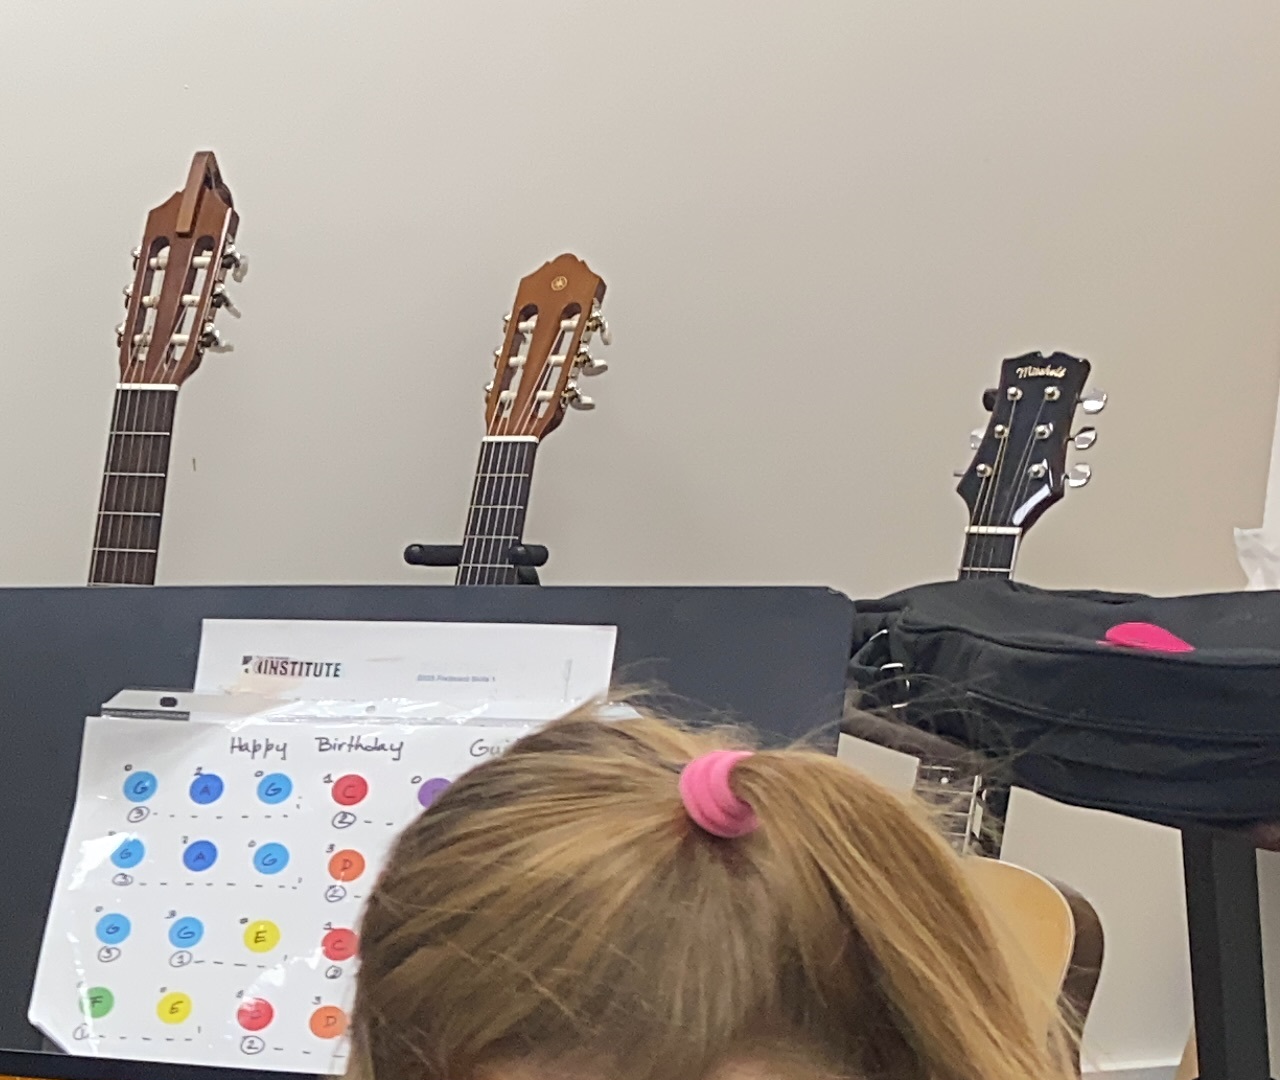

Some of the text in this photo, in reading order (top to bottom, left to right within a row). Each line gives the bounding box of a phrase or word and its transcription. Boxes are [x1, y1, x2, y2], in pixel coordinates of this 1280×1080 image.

[262, 659, 342, 678] INSTITUTE
[230, 736, 510, 761] Happy Birthday Gui
[133, 781, 357, 798] G A G C
[193, 851, 205, 862] A
[262, 853, 277, 866] G
[177, 926, 195, 939] G
[254, 930, 267, 943] E
[333, 939, 345, 950] C
[169, 1001, 184, 1014] E
[324, 1016, 337, 1027] D
